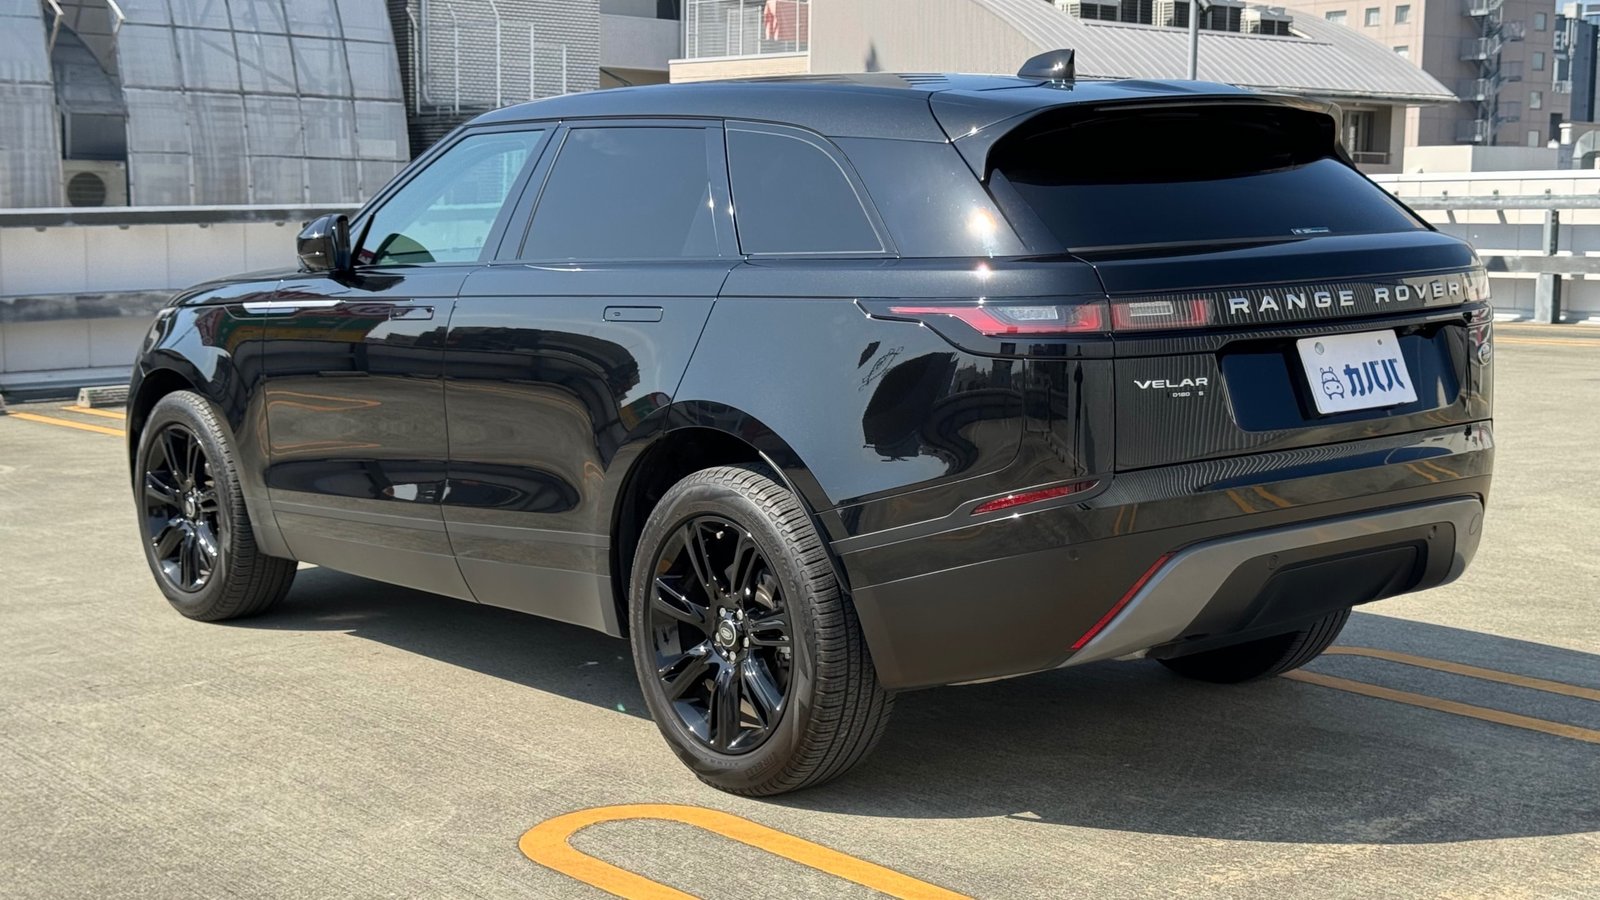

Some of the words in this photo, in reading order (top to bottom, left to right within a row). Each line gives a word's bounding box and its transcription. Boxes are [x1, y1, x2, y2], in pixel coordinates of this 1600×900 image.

[1228, 290, 1354, 315] RANGE
[1374, 281, 1460, 304] ROVER
[1133, 377, 1208, 389] VELAR
[1343, 358, 1405, 397] カババ
